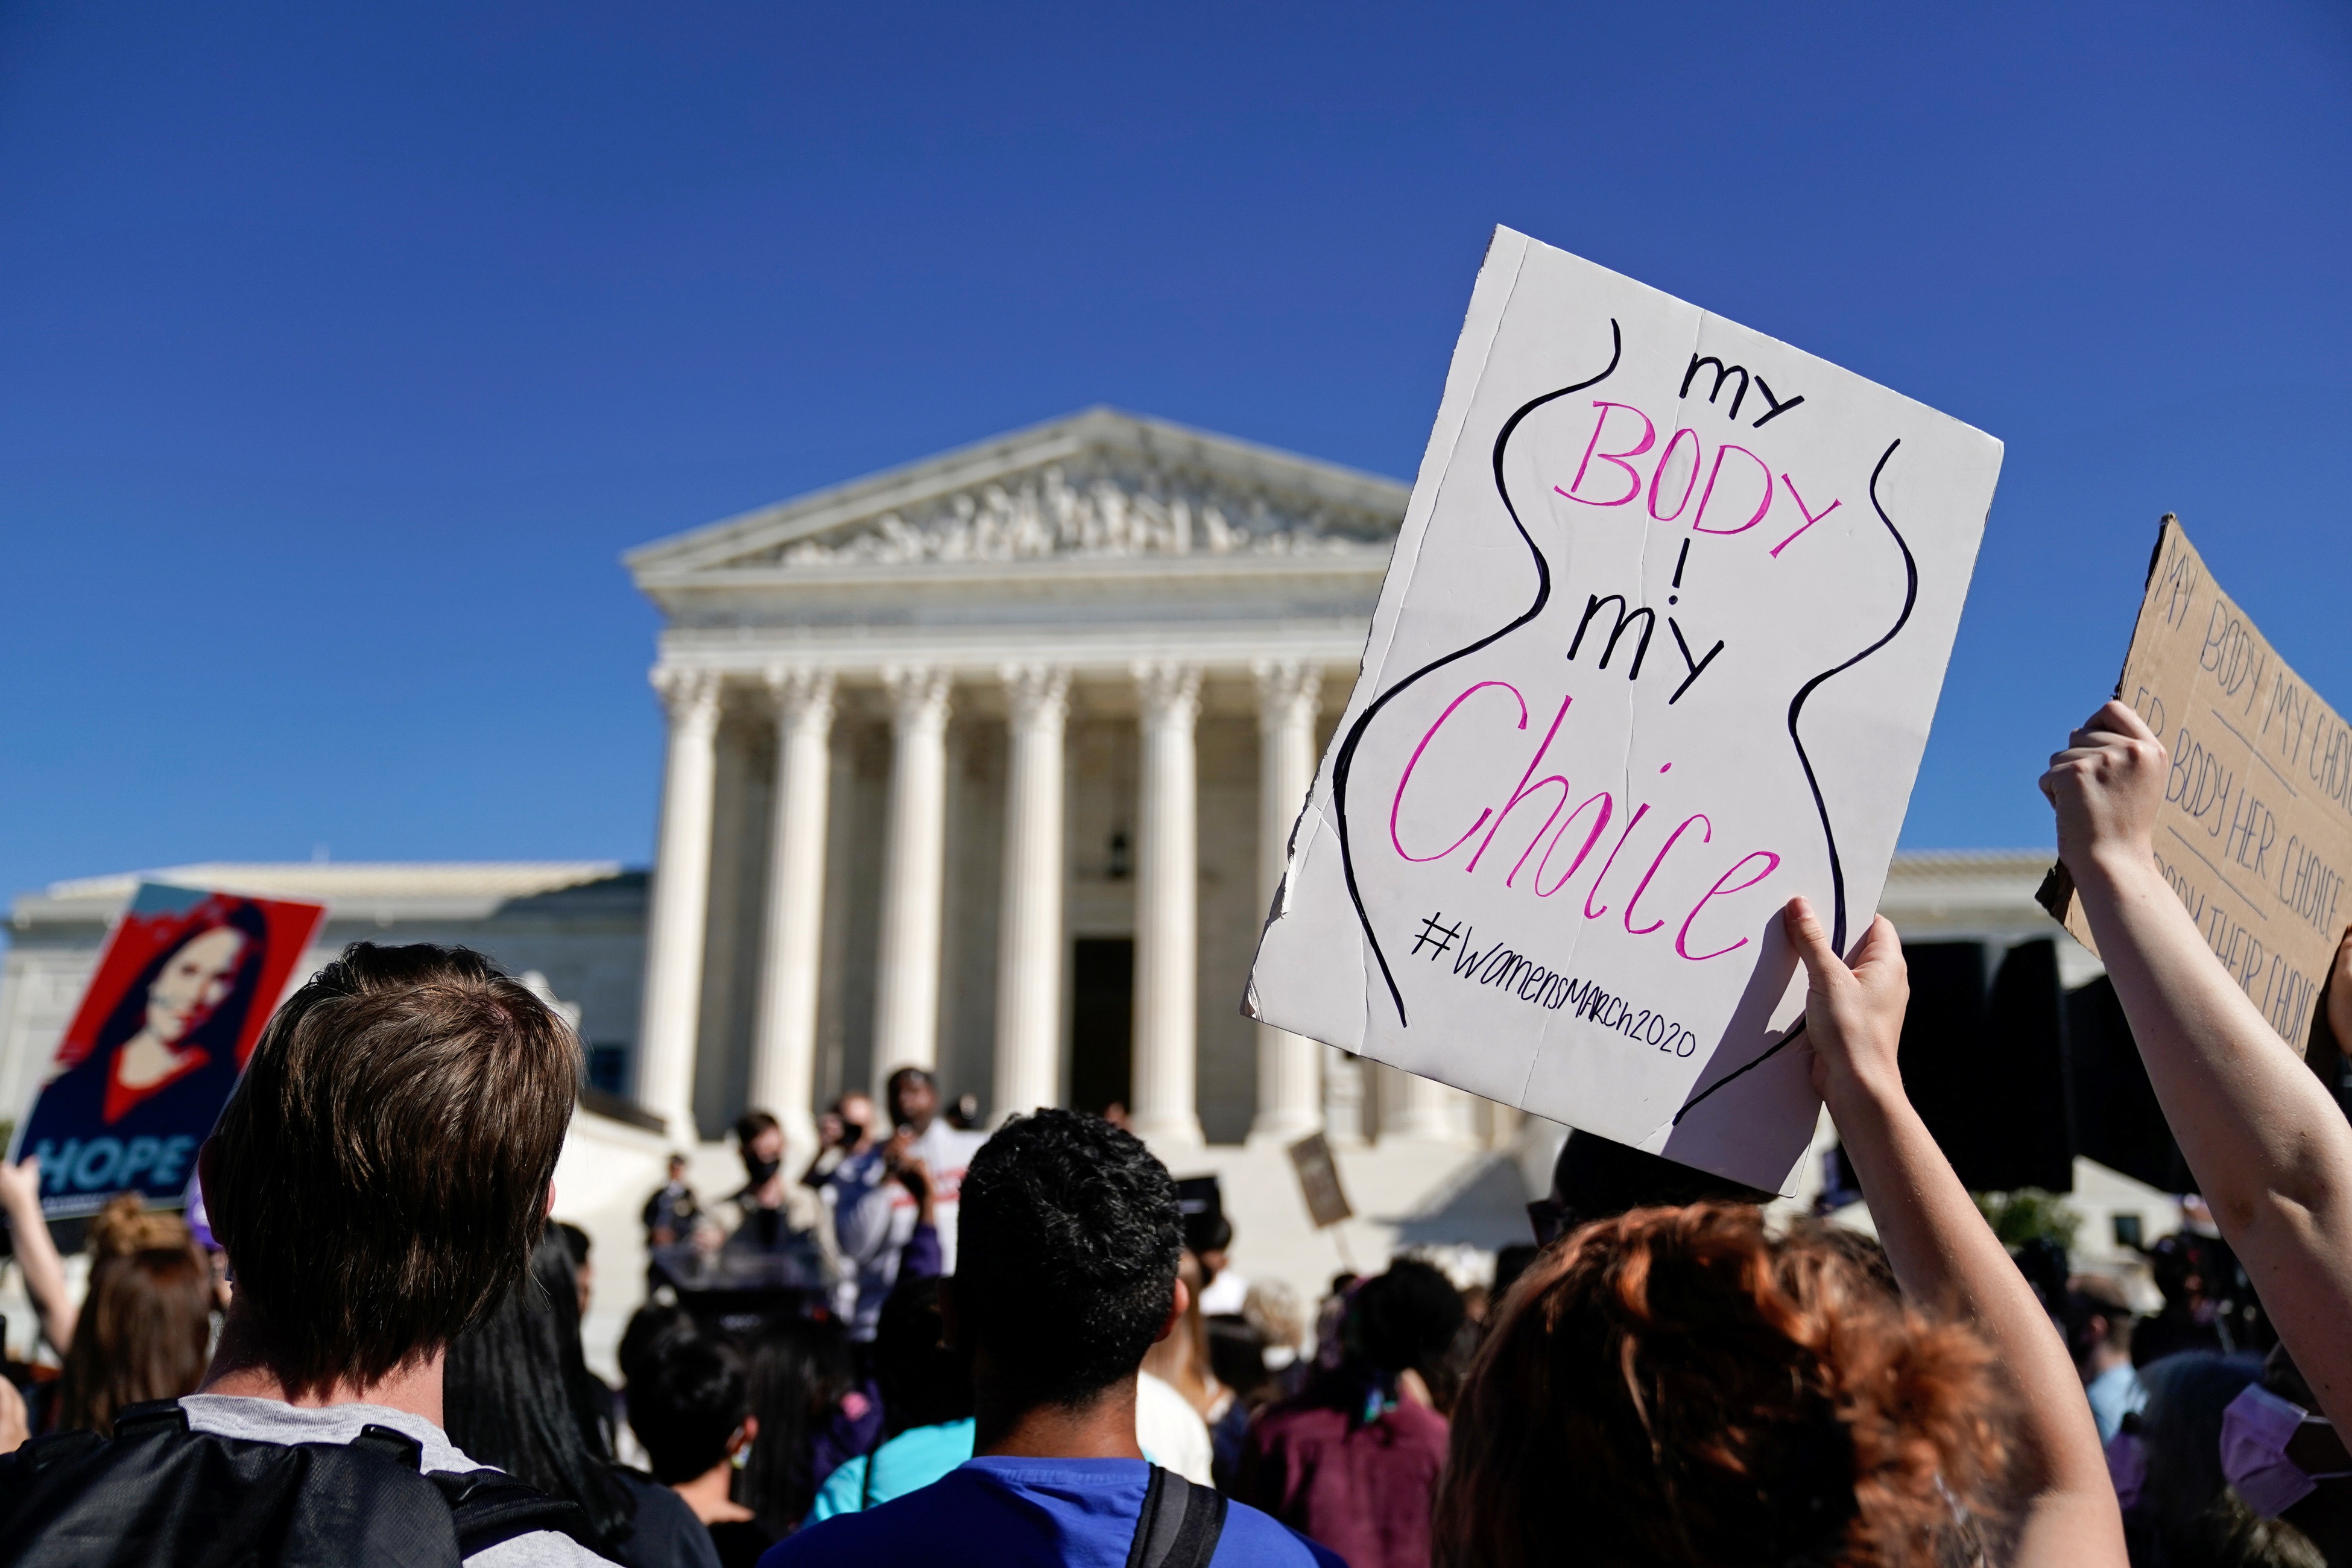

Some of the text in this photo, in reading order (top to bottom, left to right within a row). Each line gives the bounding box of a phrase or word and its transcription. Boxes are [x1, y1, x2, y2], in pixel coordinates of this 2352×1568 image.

[1680, 353, 1805, 428] my
[1554, 400, 1842, 558] BODY
[1566, 593, 1725, 705] my
[2154, 536, 2352, 815] MY BODY MY CHOI
[1390, 681, 1781, 960] Choice
[2166, 727, 2344, 943] BODY HER CHOICE
[2262, 953, 2322, 1052] CHOIC
[35, 1134, 196, 1192] HOPE
